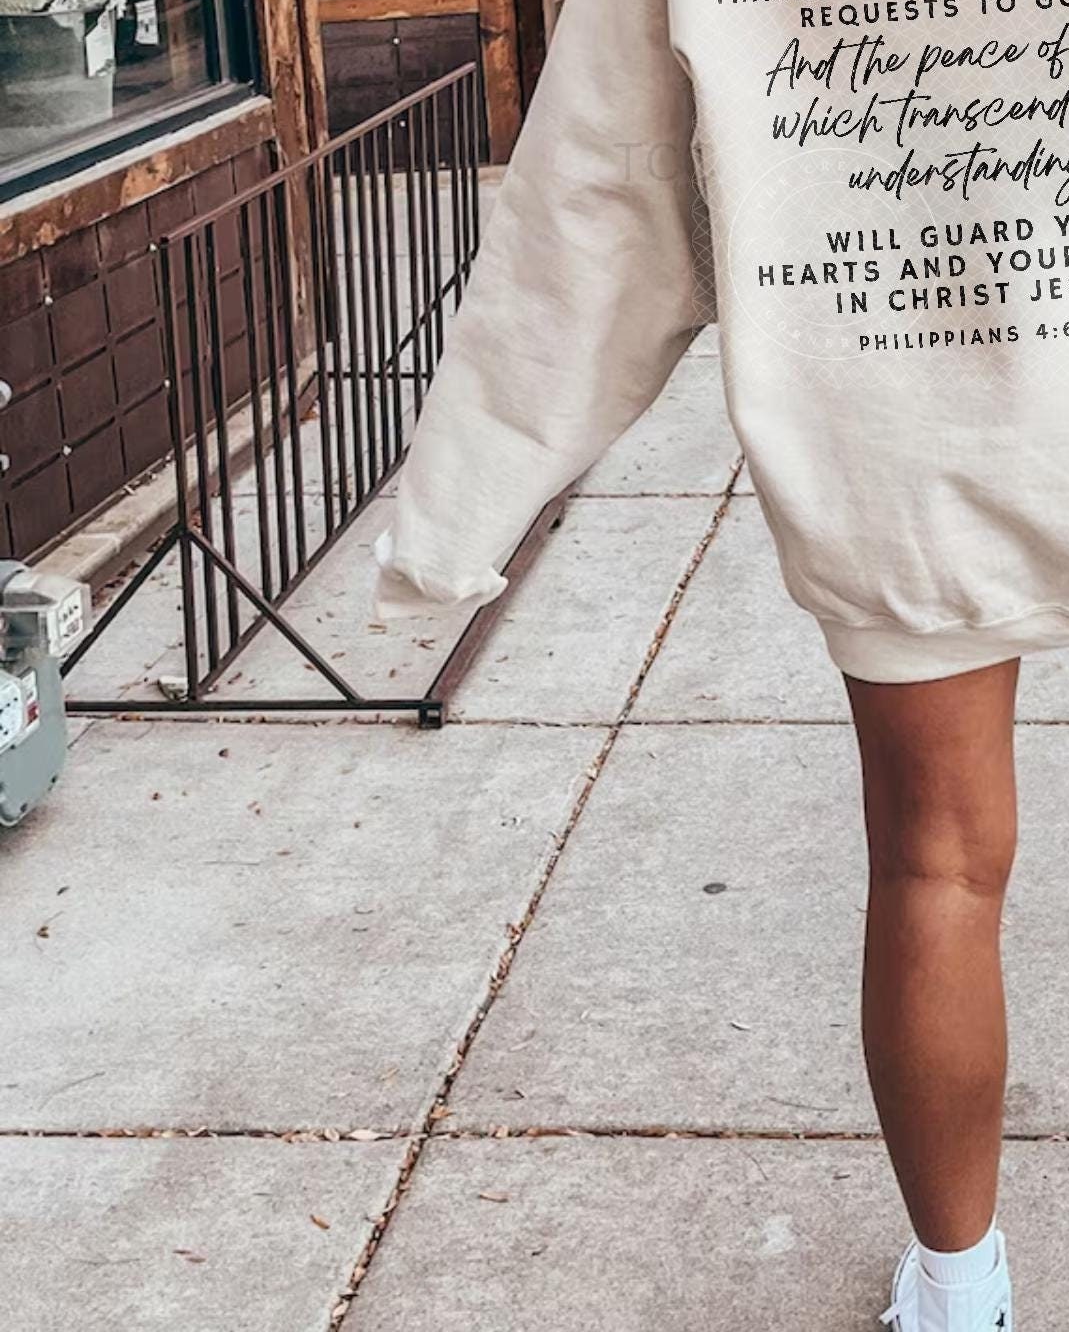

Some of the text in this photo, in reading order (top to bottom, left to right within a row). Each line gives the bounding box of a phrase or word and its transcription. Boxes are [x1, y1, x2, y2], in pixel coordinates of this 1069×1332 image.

[766, 37, 845, 96] And
[833, 35, 910, 93] the
[915, 41, 1029, 87] peace
[773, 93, 883, 147] which
[826, 229, 900, 253] WILL
[921, 219, 1033, 247] GUARD
[759, 261, 879, 286] HEARTS
[900, 255, 965, 280] AND
[837, 292, 867, 313] IN
[889, 282, 1009, 311] CHRIST
[860, 326, 1018, 350] PHILIPPIANS
